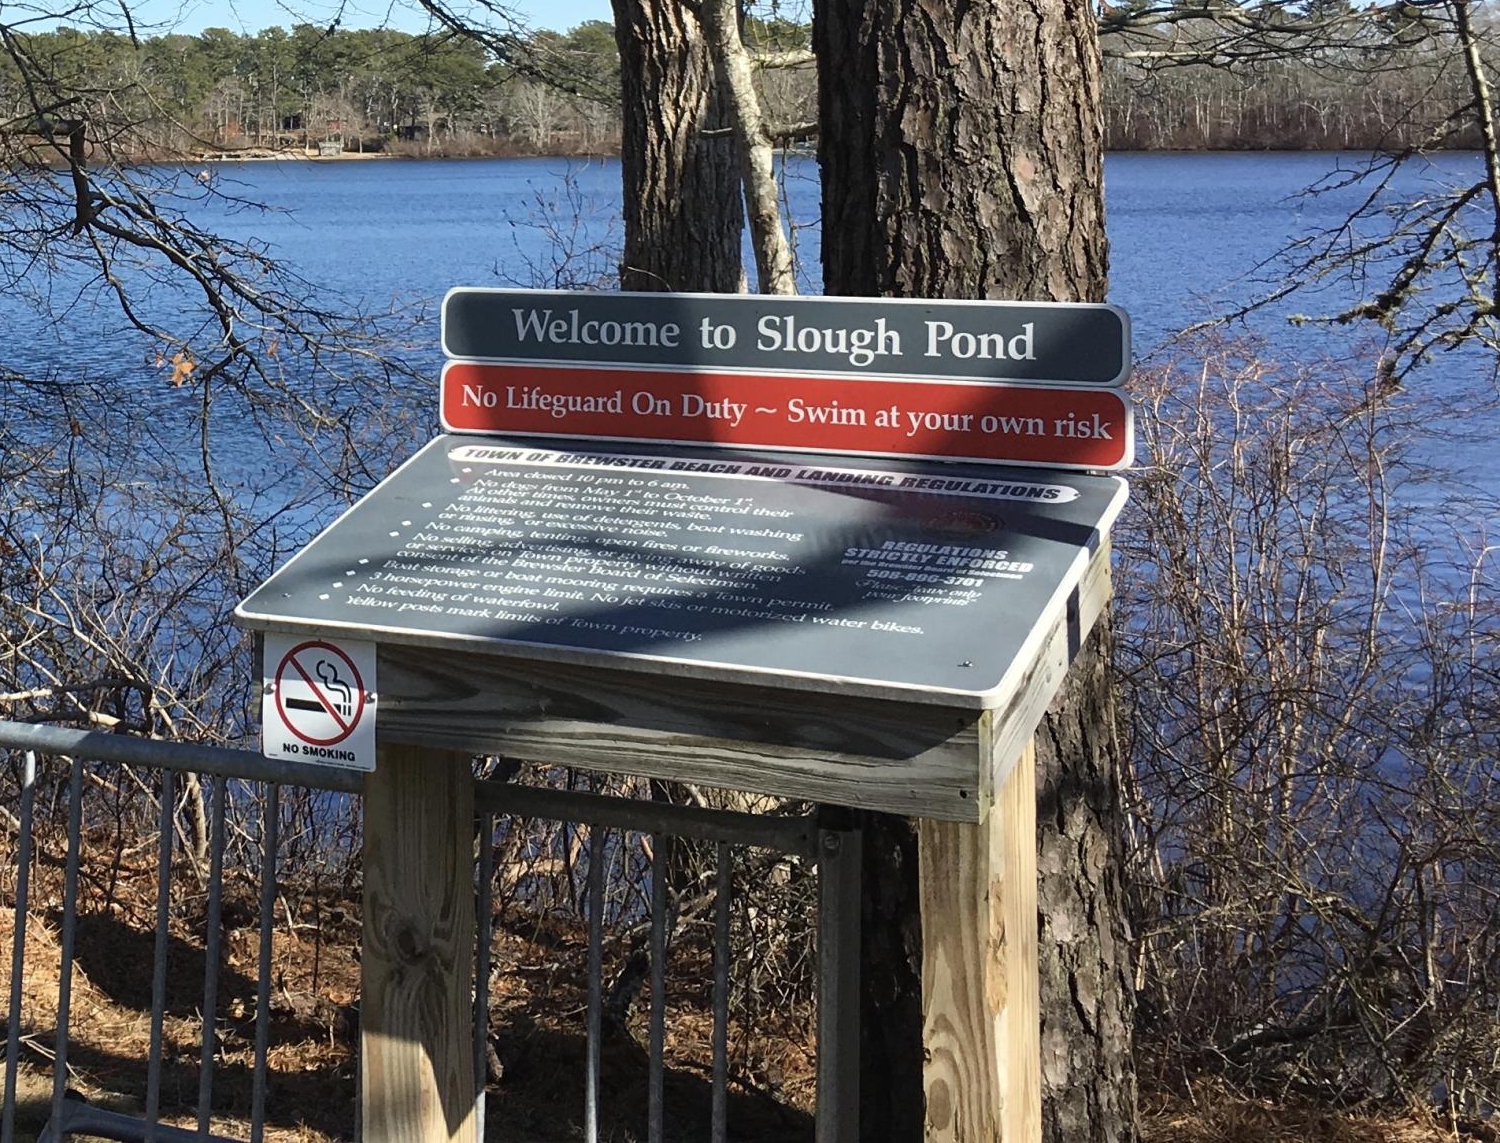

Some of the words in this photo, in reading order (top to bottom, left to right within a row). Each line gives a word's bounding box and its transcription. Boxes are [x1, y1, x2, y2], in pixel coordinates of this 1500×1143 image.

[512, 308, 680, 347] Welcome
[700, 317, 736, 350] to
[757, 315, 903, 367] Slough
[924, 320, 1037, 360] Pond
[462, 384, 498, 408] No
[506, 386, 622, 419] Lifeguard
[632, 391, 673, 417] On
[682, 393, 747, 427] Duty
[787, 398, 867, 427] Swim
[874, 406, 901, 428] at
[906, 412, 975, 438] your
[980, 415, 1046, 436] own
[1054, 413, 1113, 441] risk
[465, 448, 522, 461] TOWN
[529, 451, 554, 463] OF
[555, 453, 666, 469] BREWSTER
[669, 460, 743, 475] BEACH
[744, 465, 792, 479] AND
[795, 469, 894, 486] LANDING
[899, 476, 1061, 500] REGULATIONS
[473, 478, 499, 488] No
[505, 481, 538, 491] dogs
[540, 483, 579, 494] from
[582, 486, 620, 497] May
[643, 491, 660, 499] to
[664, 492, 731, 505] October
[484, 468, 521, 478] Area
[523, 471, 573, 482] closed
[575, 474, 593, 483] 10
[594, 477, 623, 485] pm
[628, 478, 644, 486] to
[647, 479, 658, 487] 6
[661, 482, 690, 490] am.
[457, 494, 518, 505] animals
[520, 498, 552, 507] and
[554, 502, 617, 513] remove
[619, 505, 659, 516] their
[663, 509, 713, 521] waste.
[465, 486, 485, 494] At
[487, 488, 530, 498] other
[580, 495, 641, 506] owners
[643, 500, 689, 509] must
[691, 503, 750, 516] control
[752, 507, 794, 518] their
[445, 503, 471, 512] No
[542, 512, 570, 520] use
[572, 513, 593, 522] of
[592, 515, 682, 530] detergents,
[687, 522, 726, 534] boat
[729, 526, 804, 542] washing
[545, 521, 619, 533] excessive
[621, 527, 668, 538] noise.
[412, 532, 440, 542] No
[617, 551, 674, 565] giving
[677, 558, 726, 570] away
[729, 561, 751, 570] of
[425, 521, 451, 531] No
[595, 537, 639, 547] open
[642, 539, 678, 551] fires
[682, 545, 703, 553] or
[704, 545, 790, 561] fireworks.
[882, 540, 1009, 560] REGULATIONS
[396, 549, 459, 562] consent
[460, 555, 482, 563] of
[481, 556, 509, 566] the
[511, 558, 586, 573] Brewster
[588, 565, 642, 578] Board
[643, 572, 664, 582] of
[665, 573, 760, 590] Selectmen.
[425, 544, 488, 555] services
[490, 549, 513, 557] on
[519, 550, 563, 561] Town
[563, 556, 640, 571] property
[645, 562, 713, 576] without
[719, 570, 782, 583] written
[844, 547, 933, 563] STRICTLY
[935, 556, 1035, 573] ENFORCED
[878, 561, 923, 571] Brewster
[383, 560, 420, 572] Boat
[421, 564, 481, 578] storage
[483, 571, 503, 579] or
[505, 570, 543, 583] boat
[544, 576, 619, 591] mooring
[622, 583, 694, 597] requires
[716, 591, 763, 604] Town
[767, 599, 835, 612] permit.
[866, 569, 985, 587] 508-896-3701
[356, 584, 383, 594] No
[385, 586, 448, 602] feeding
[450, 593, 472, 602] of
[473, 595, 560, 612] waterfowl.
[369, 572, 383, 580] 3
[383, 573, 481, 590] horsepower
[482, 582, 540, 595] engine
[542, 587, 585, 600] limit.
[590, 593, 619, 603] No
[620, 595, 645, 607] jet
[649, 599, 682, 610] skis
[686, 603, 708, 612] or
[711, 606, 806, 623] motorized
[811, 616, 867, 629] water
[870, 620, 925, 635] bikes.
[345, 596, 399, 608] Yellow
[397, 602, 444, 613] posts
[446, 607, 493, 618] mark
[494, 610, 542, 624] limits
[545, 616, 567, 626] of
[571, 618, 616, 632] Town
[620, 625, 702, 642] property.
[283, 743, 299, 754] NO
[302, 745, 356, 762] SMOKING
